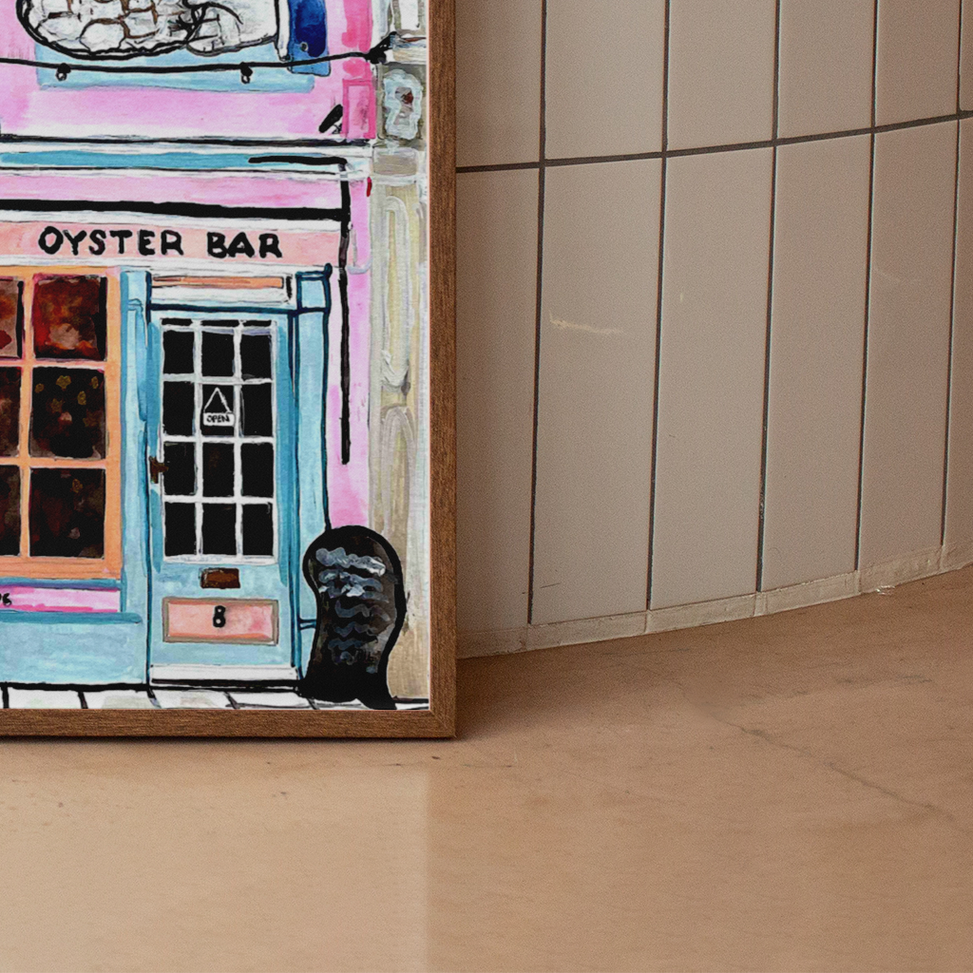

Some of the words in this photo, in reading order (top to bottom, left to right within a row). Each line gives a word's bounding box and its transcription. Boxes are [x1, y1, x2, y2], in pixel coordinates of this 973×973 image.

[38, 225, 184, 255] OYSTER
[206, 230, 283, 259] BAR
[213, 605, 226, 628] 8
